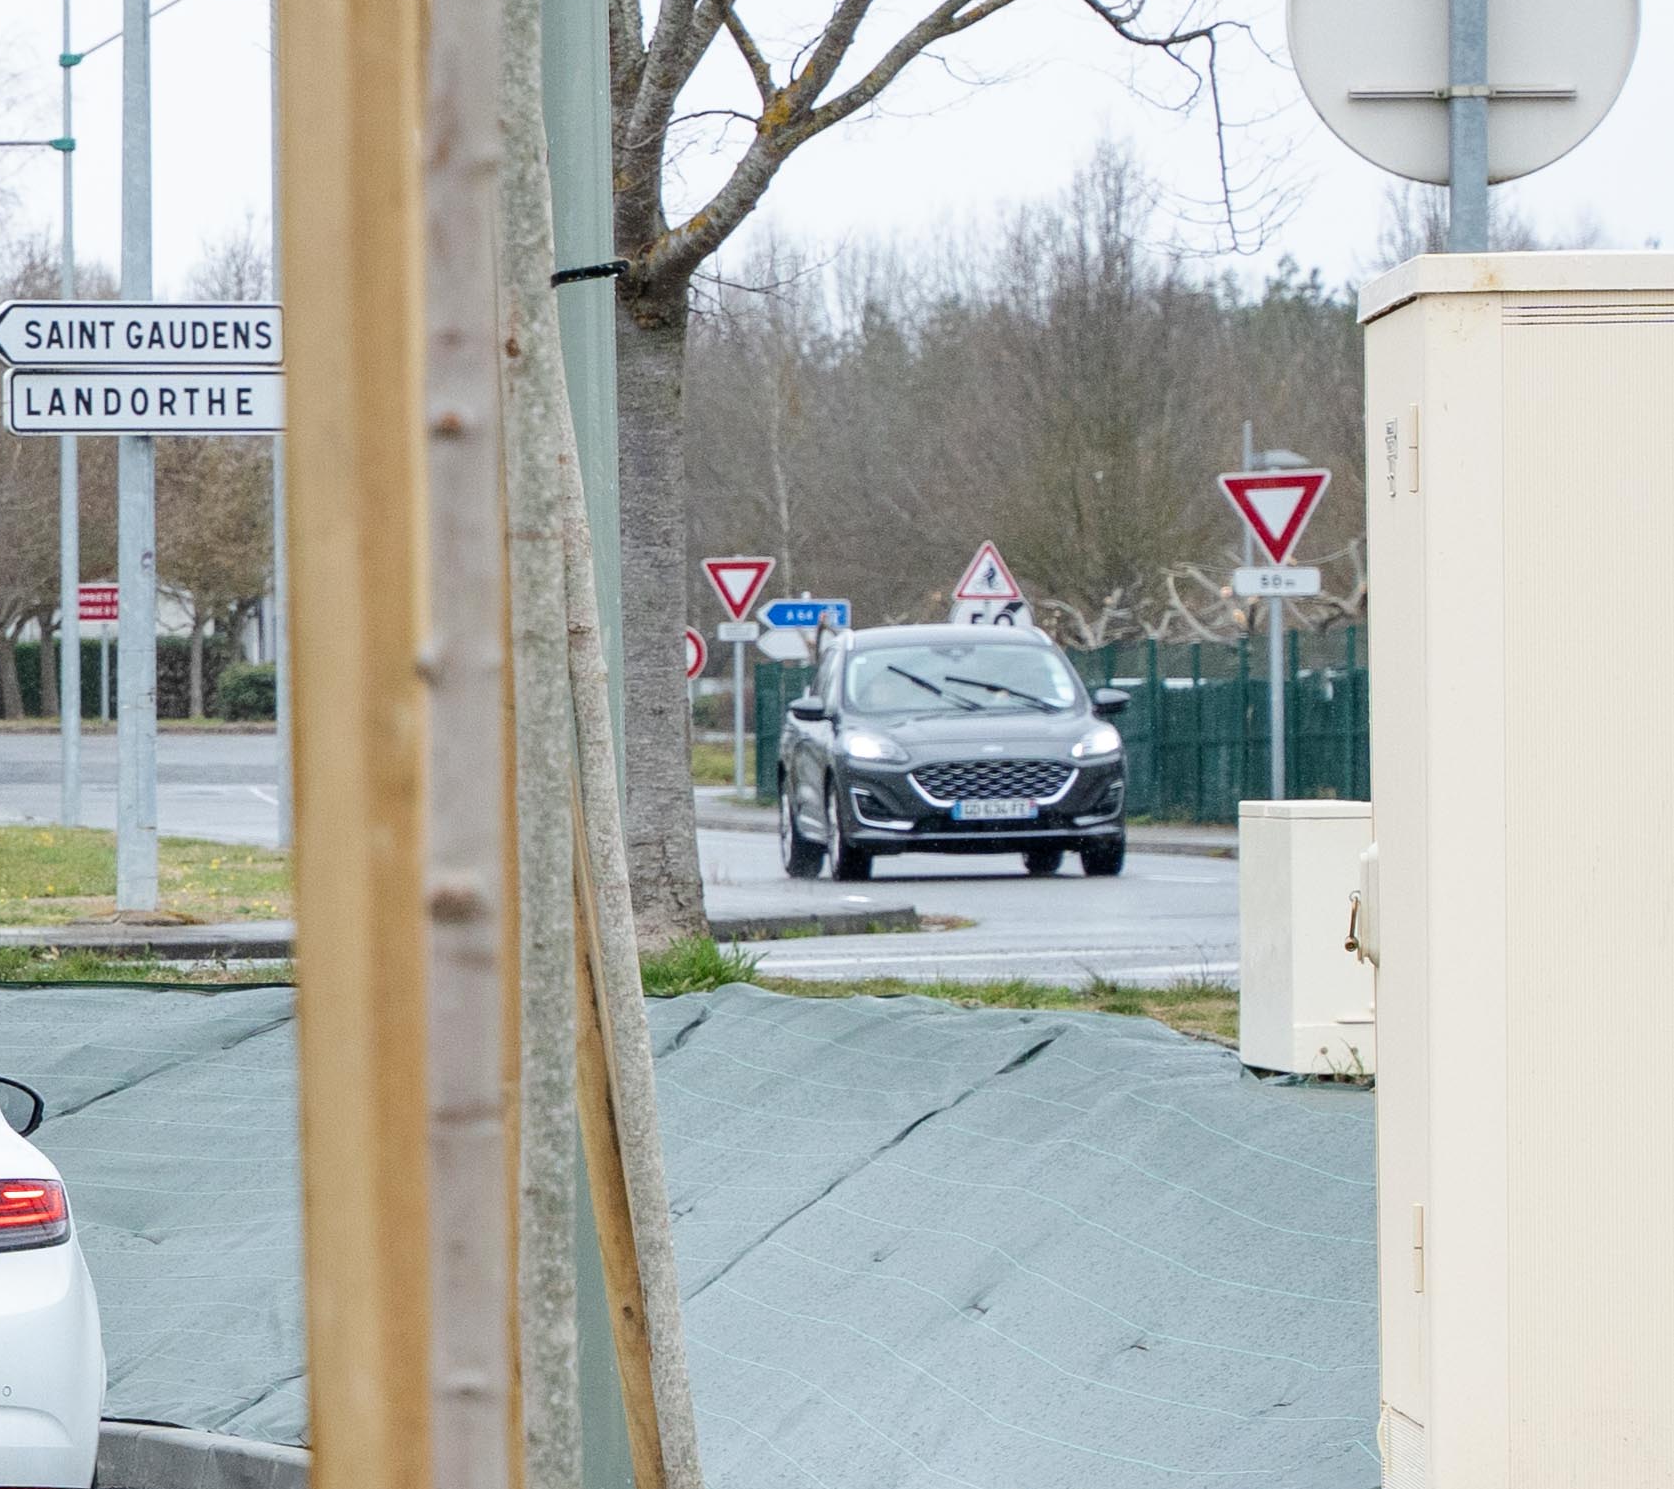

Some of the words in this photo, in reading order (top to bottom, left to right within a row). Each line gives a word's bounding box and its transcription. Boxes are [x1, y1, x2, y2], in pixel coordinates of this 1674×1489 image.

[25, 320, 115, 349] SAINT
[126, 320, 272, 349] GAUDENS
[26, 388, 253, 416] LANDORTHE
